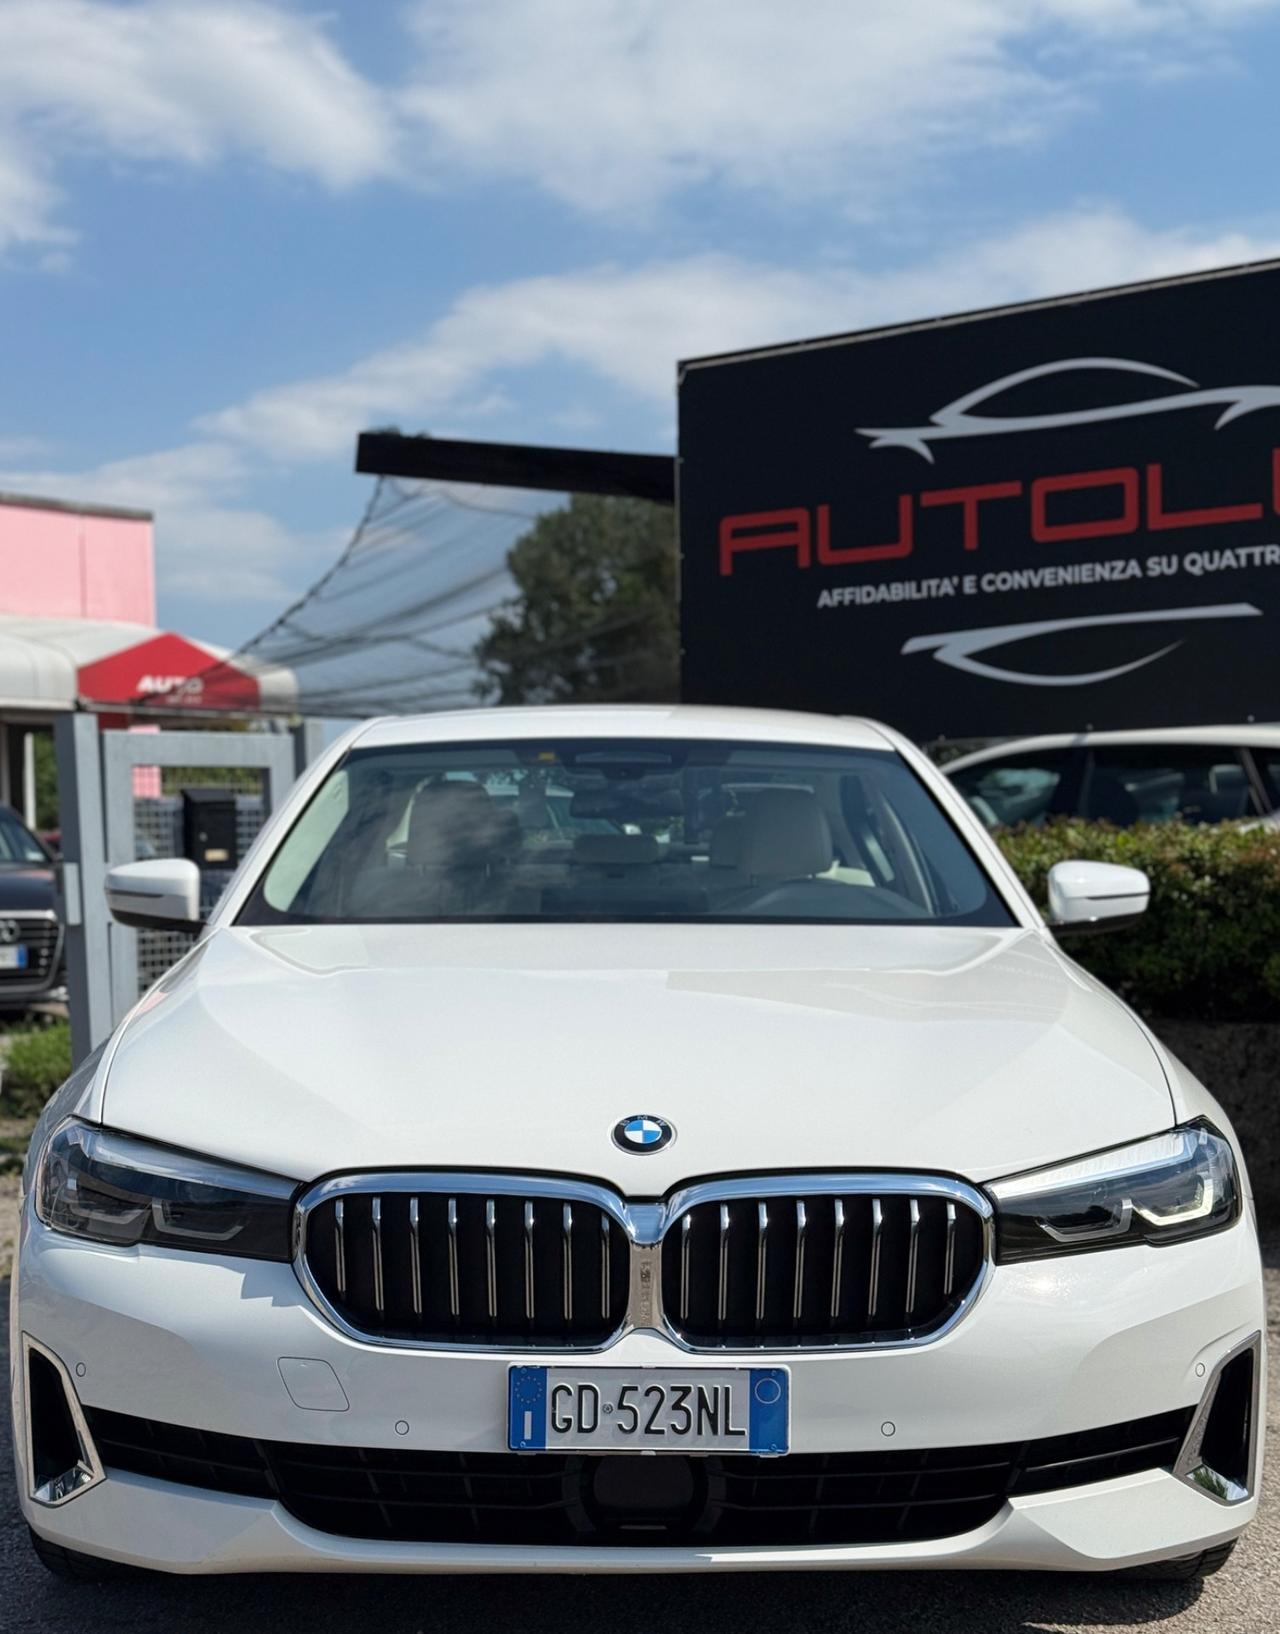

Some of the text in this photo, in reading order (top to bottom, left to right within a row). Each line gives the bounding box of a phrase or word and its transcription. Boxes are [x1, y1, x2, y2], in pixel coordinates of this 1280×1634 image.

[719, 447, 1280, 576] AUTOL
[817, 576, 959, 608] AFFIDABILITA'
[963, 576, 977, 594] E
[980, 558, 1143, 593] CONVENIENZA
[1146, 554, 1179, 577] SU
